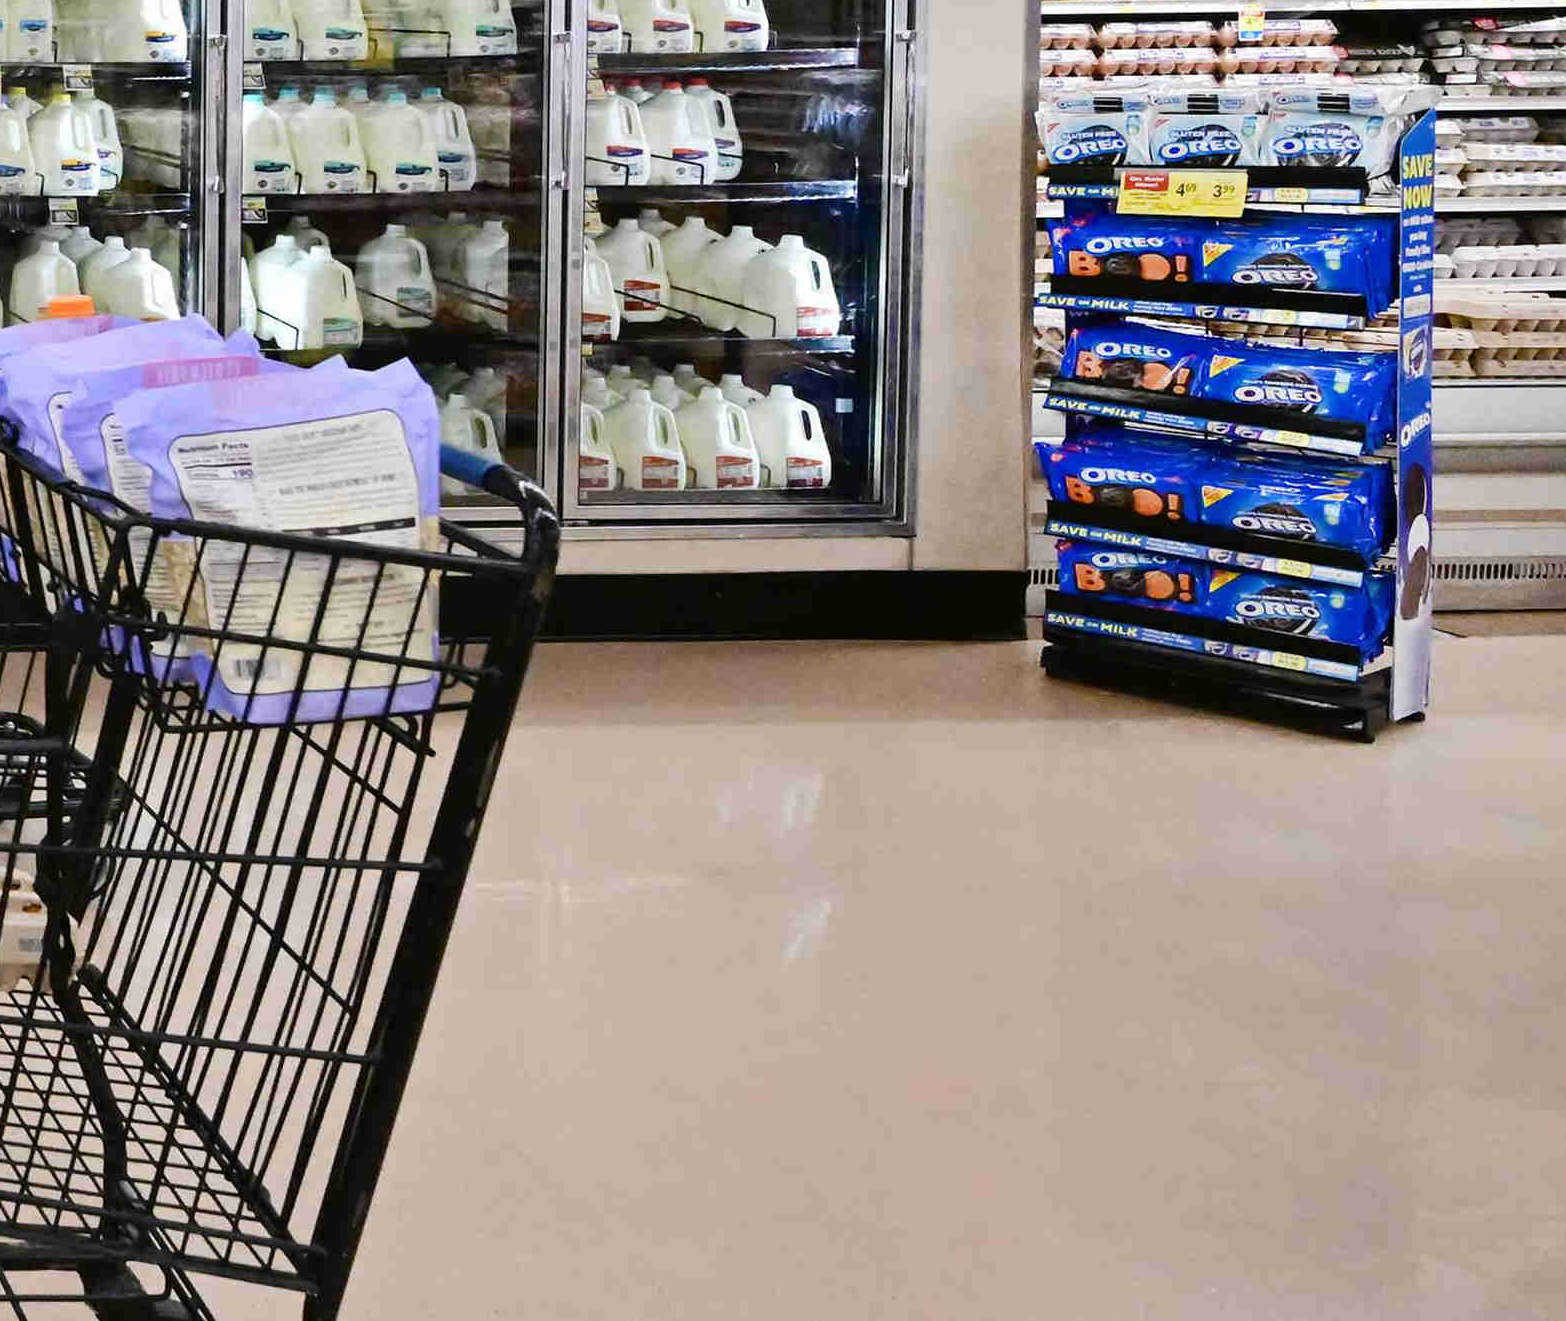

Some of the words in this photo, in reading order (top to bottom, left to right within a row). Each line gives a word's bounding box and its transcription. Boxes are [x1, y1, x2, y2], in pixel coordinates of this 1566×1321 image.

[1052, 135, 1127, 163] OREO
[1159, 134, 1243, 161] OREO
[1271, 133, 1364, 156] OREO
[1402, 155, 1433, 179] SAVE
[1048, 186, 1086, 197] SAVE
[1403, 184, 1433, 210] NOW
[1086, 236, 1165, 255] OREO
[1232, 268, 1319, 285] OREO
[1037, 294, 1076, 307] SAVE
[1091, 298, 1130, 311] MILK
[1095, 341, 1172, 359] OREO
[1234, 385, 1323, 405] OREO
[1048, 397, 1088, 410] SAVE
[1101, 405, 1141, 420] MILK
[1080, 466, 1157, 484] OREO
[1232, 514, 1318, 535] OREO
[1049, 523, 1089, 537] SAVE
[1103, 531, 1143, 547] MILK
[1091, 551, 1168, 569] OREO
[1234, 600, 1322, 620] OREO
[1046, 612, 1086, 628] SAVE
[1099, 621, 1139, 639] MILK
